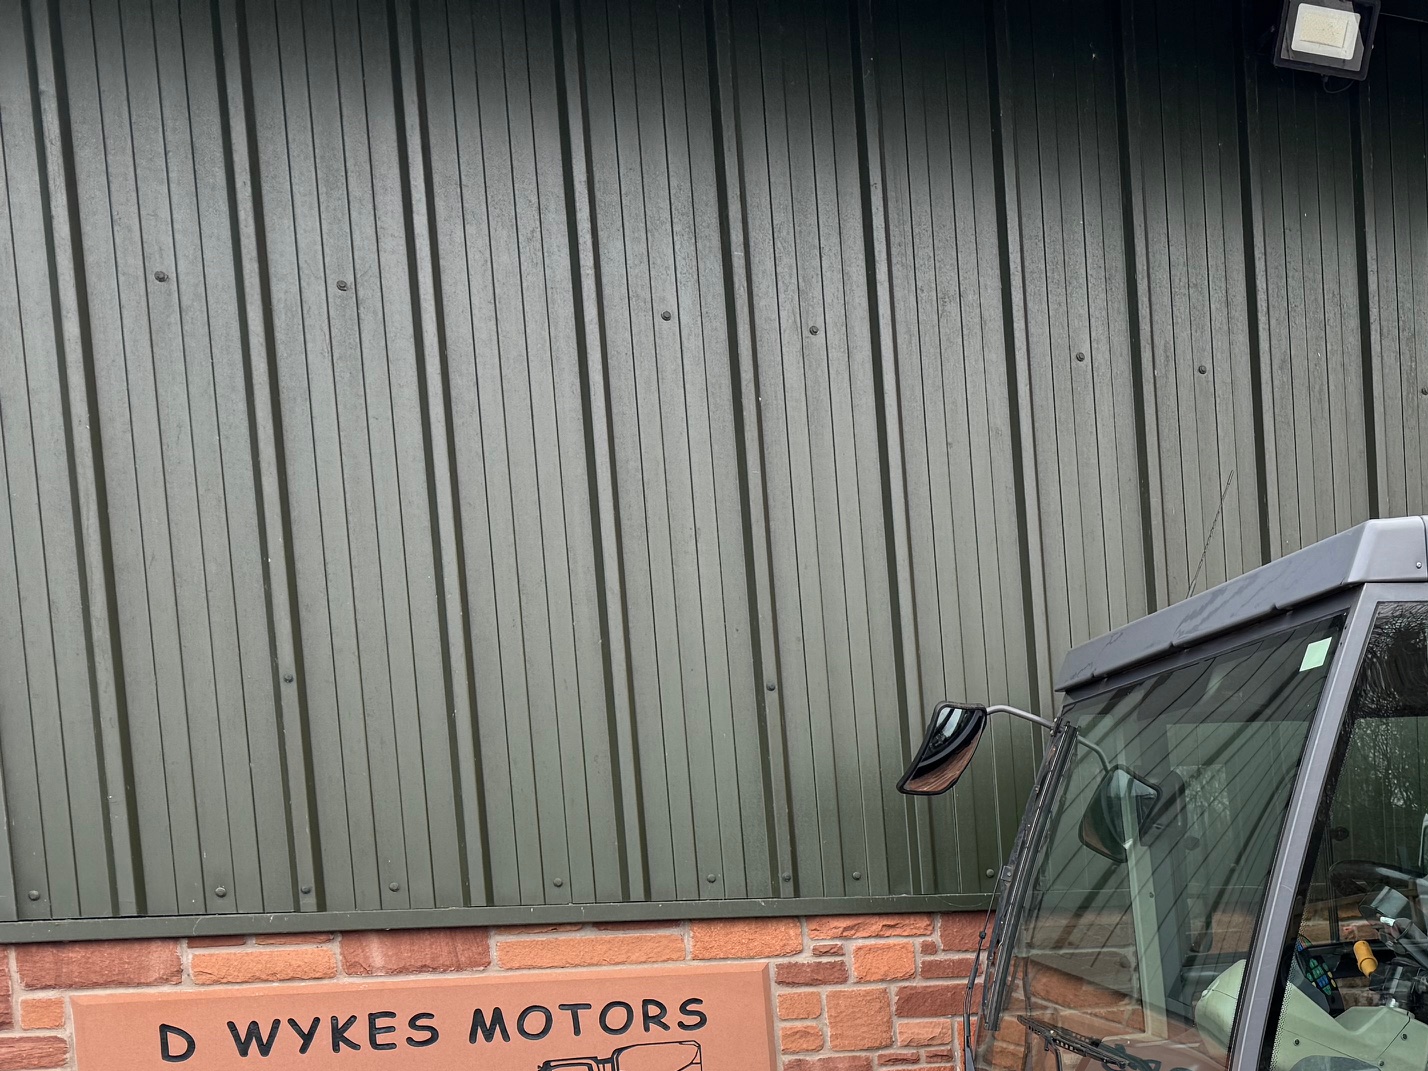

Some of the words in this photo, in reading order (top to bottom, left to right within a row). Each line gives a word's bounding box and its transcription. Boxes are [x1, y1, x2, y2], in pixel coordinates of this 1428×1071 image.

[159, 1023, 196, 1063] D
[226, 1010, 440, 1058] WYKES
[468, 997, 708, 1045] MOTORS
